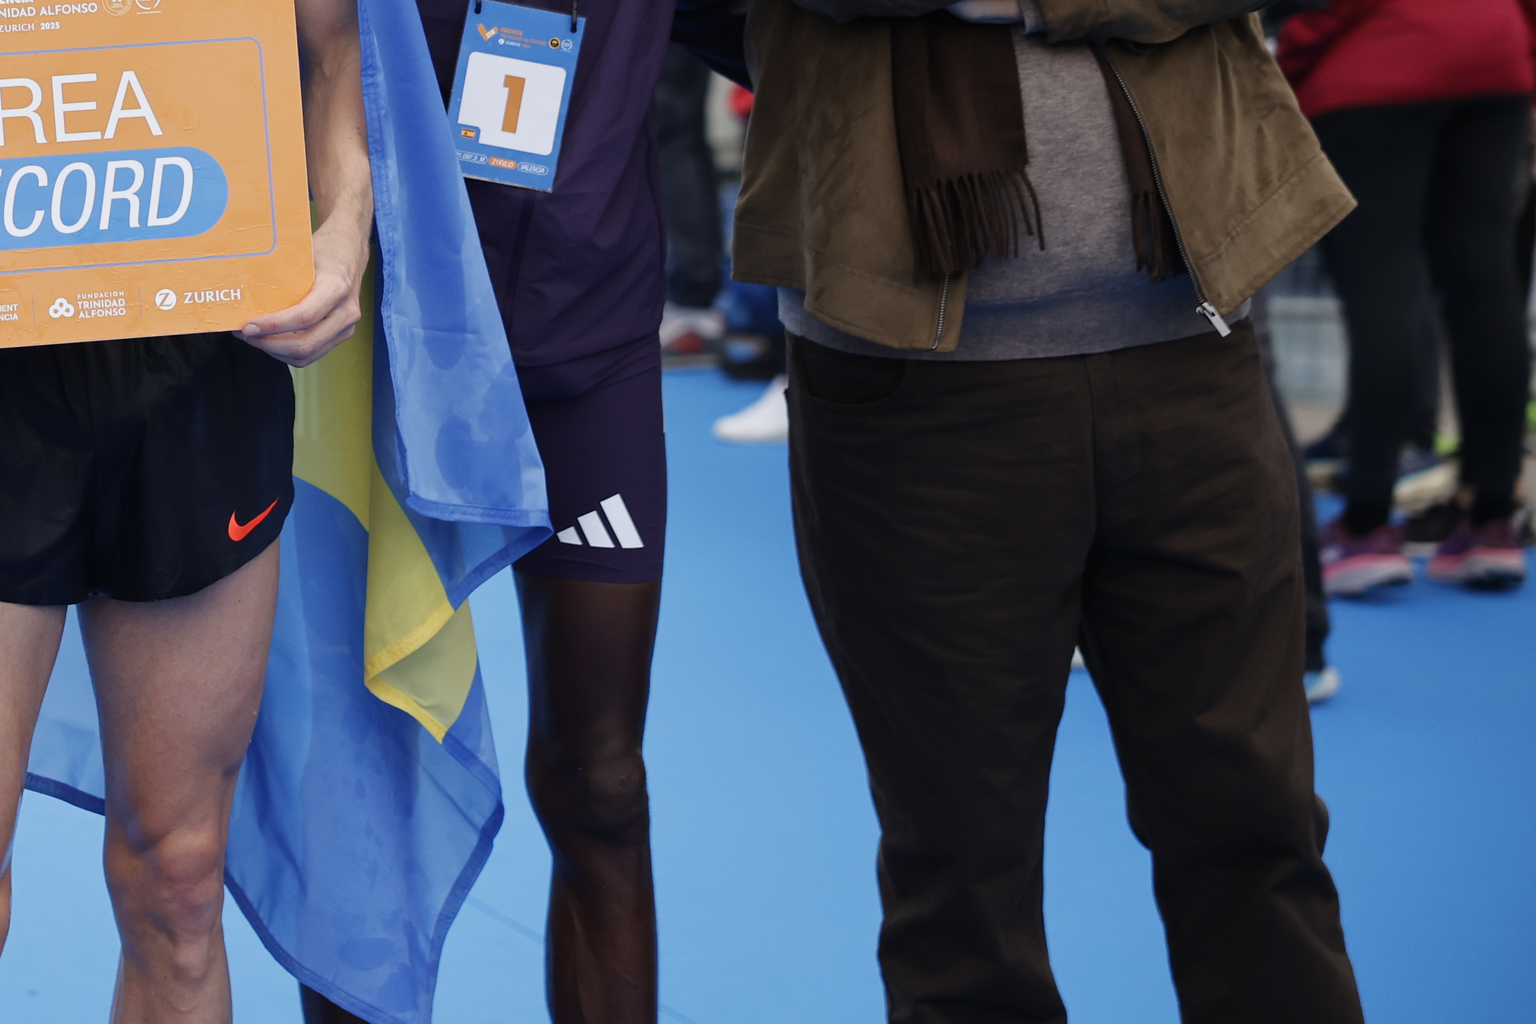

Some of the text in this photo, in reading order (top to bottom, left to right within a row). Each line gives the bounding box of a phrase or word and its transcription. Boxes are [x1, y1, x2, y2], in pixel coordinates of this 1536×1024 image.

[39, 3, 98, 18] ALFONSO
[40, 21, 60, 31] 2025
[502, 74, 526, 134] 1
[520, 164, 545, 174] VALENCIA
[77, 291, 125, 300] FUNDACIÓN
[183, 289, 242, 304] ZURICH
[77, 298, 126, 310] TRINIDAD
[78, 307, 126, 319] ALFONSO
